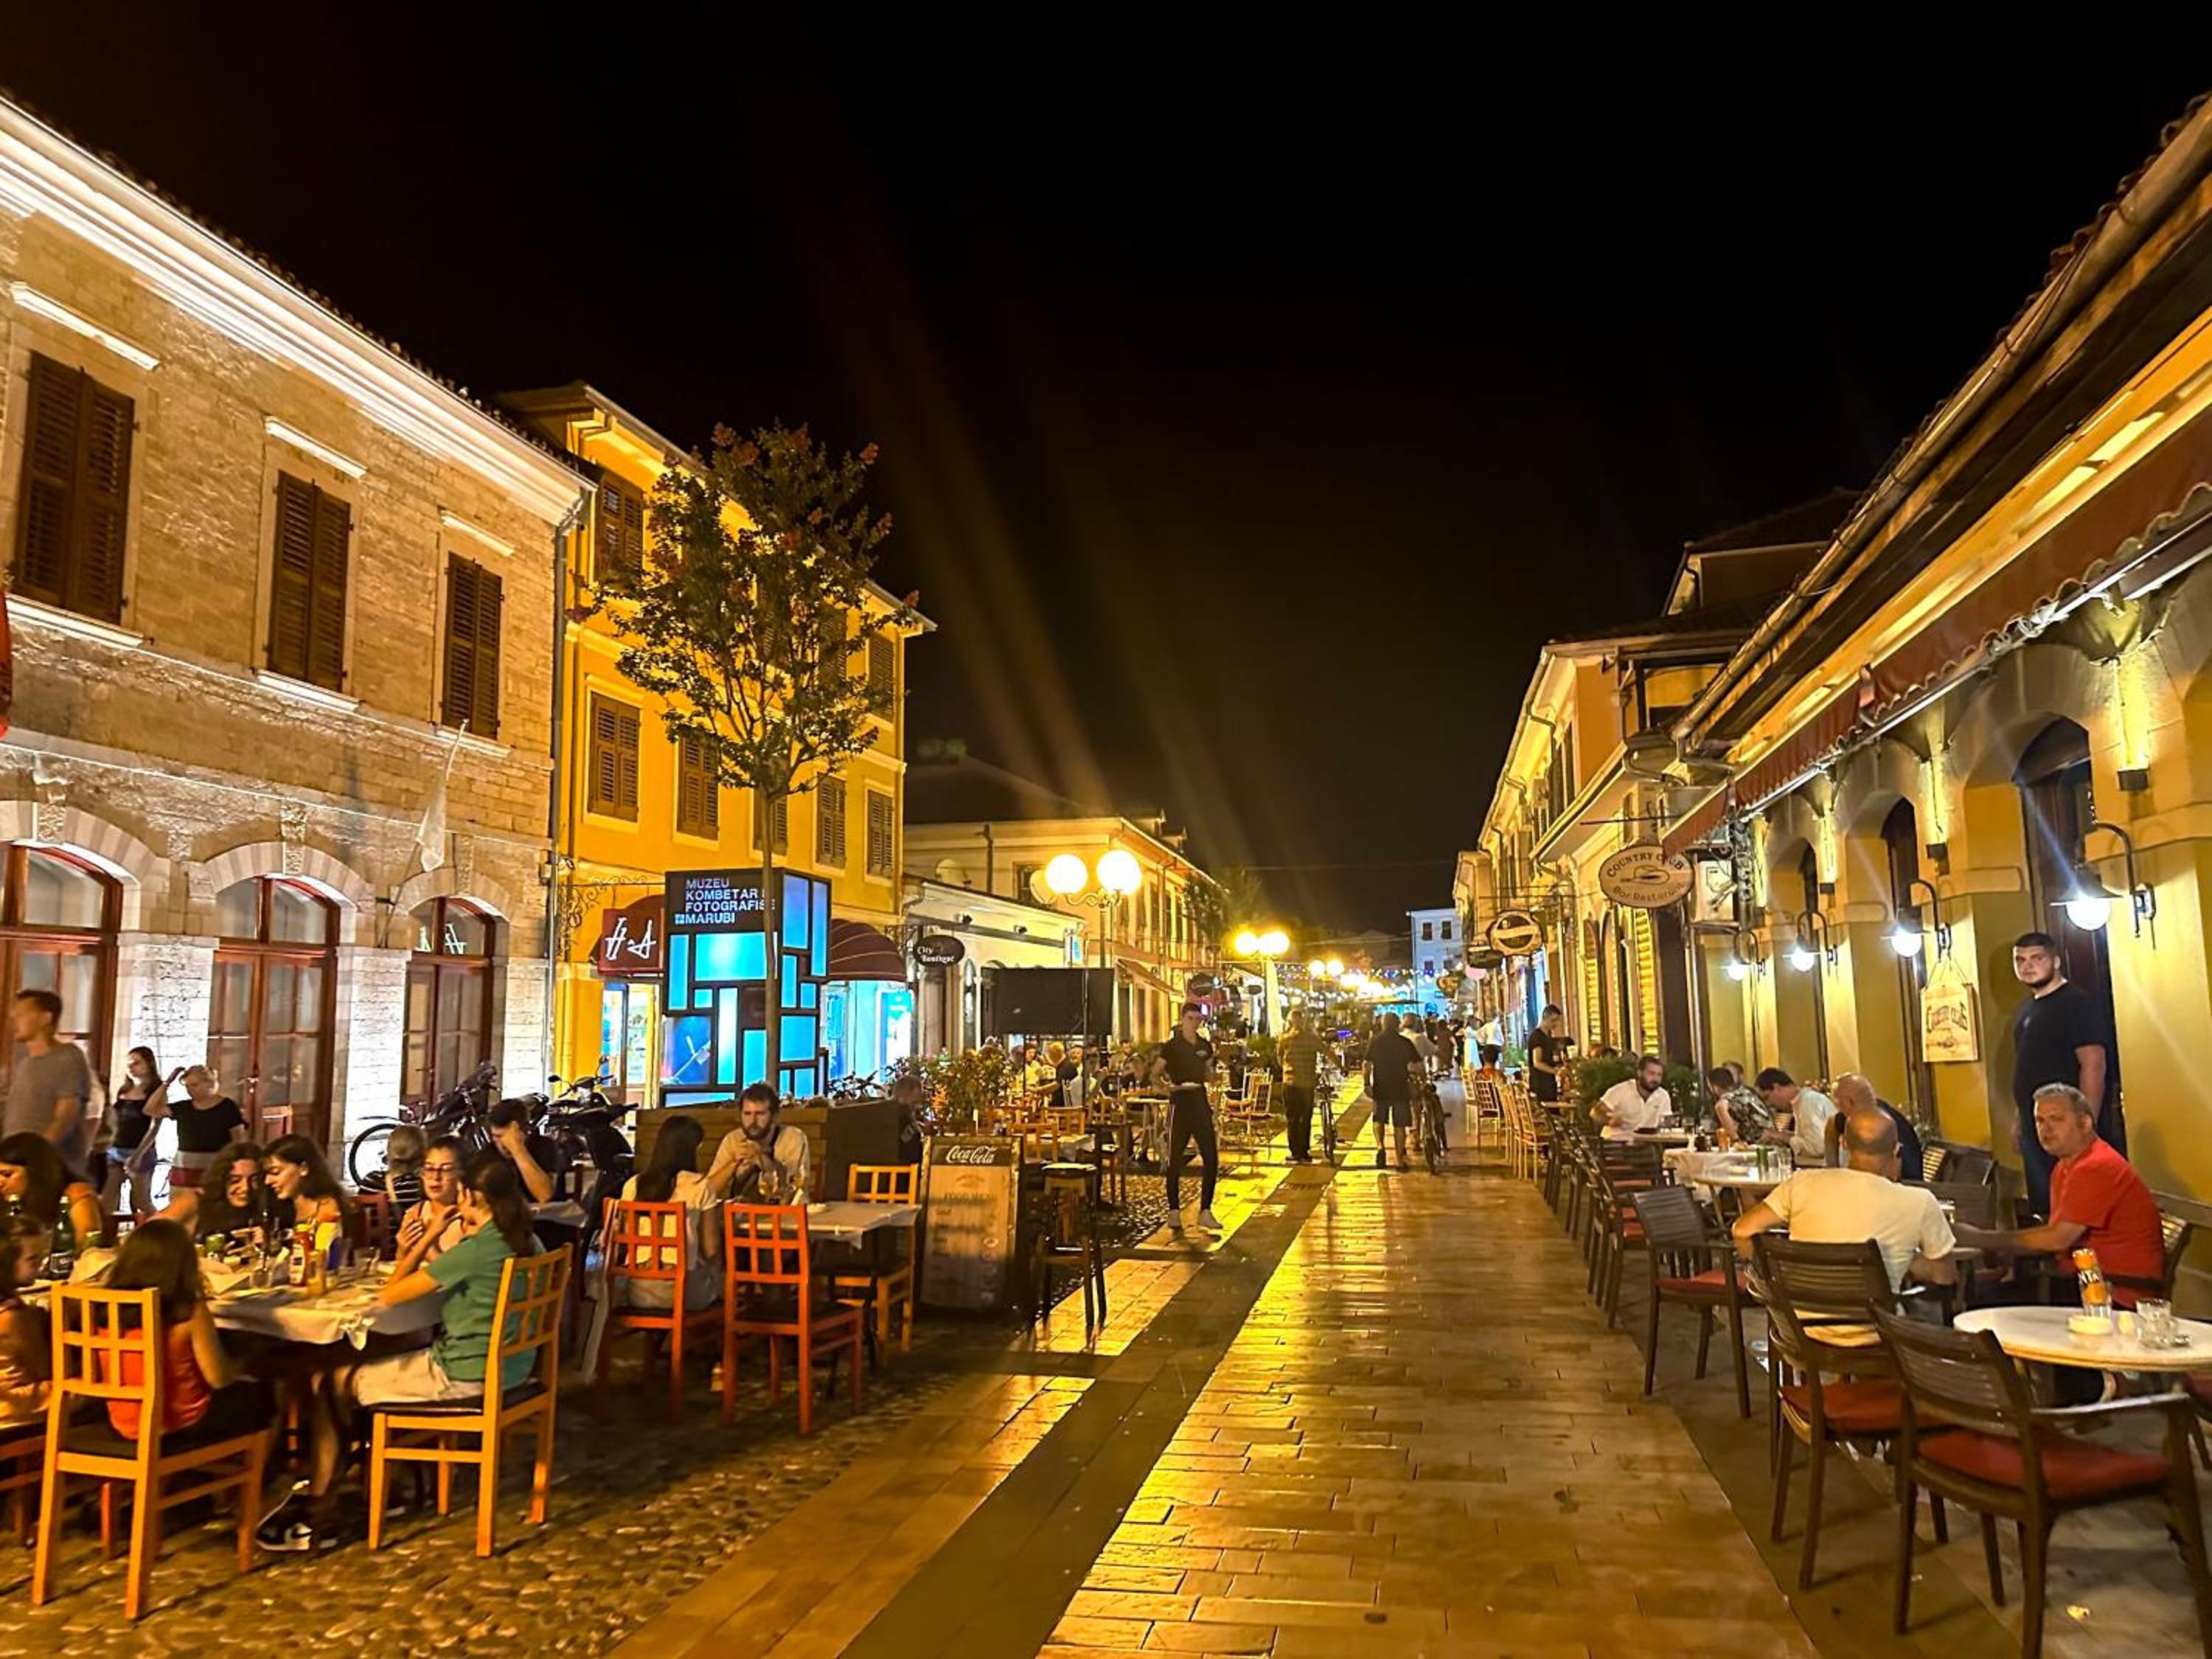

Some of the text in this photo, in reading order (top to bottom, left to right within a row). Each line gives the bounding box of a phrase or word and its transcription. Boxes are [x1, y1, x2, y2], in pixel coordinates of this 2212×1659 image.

[1607, 852, 1653, 877] COUNTRY
[686, 878, 729, 888] MUZEU
[685, 888, 759, 900] KOMBETAR
[685, 899, 776, 913] FOTOGRAFIS
[684, 912, 736, 924] MARUBI
